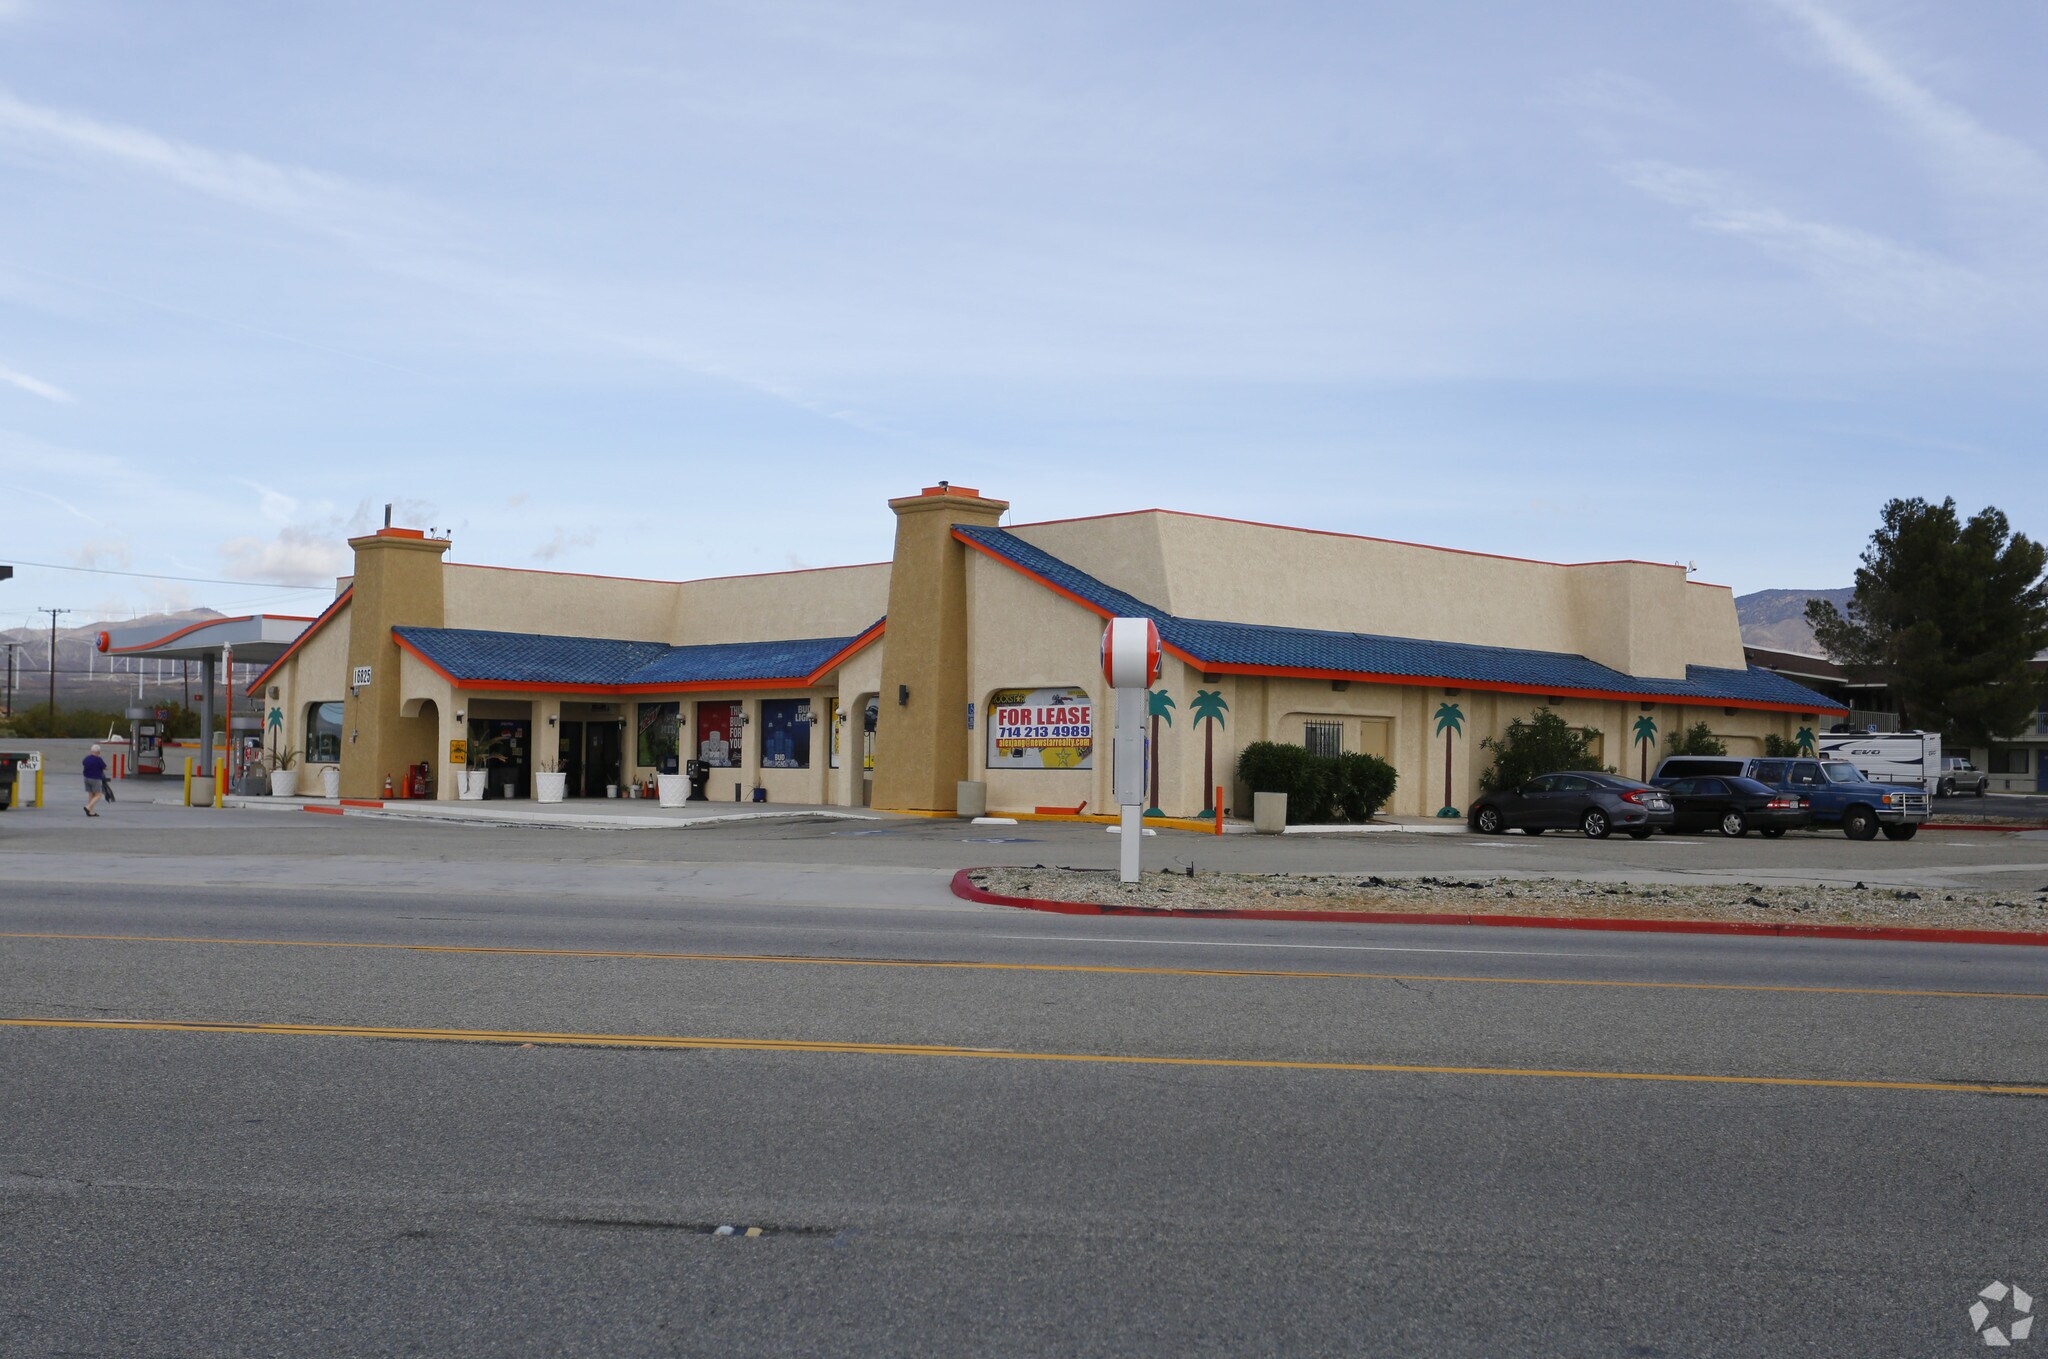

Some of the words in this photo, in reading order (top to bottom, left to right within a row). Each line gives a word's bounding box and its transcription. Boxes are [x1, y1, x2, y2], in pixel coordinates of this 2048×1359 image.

[354, 669, 371, 684] 16825
[998, 708, 1032, 726] FOR
[1037, 706, 1091, 725] LEASE
[729, 727, 742, 738] FOR
[999, 726, 1021, 738] 714
[1024, 726, 1049, 738] 213
[1052, 725, 1090, 738] 4989
[729, 738, 742, 749] YOU
